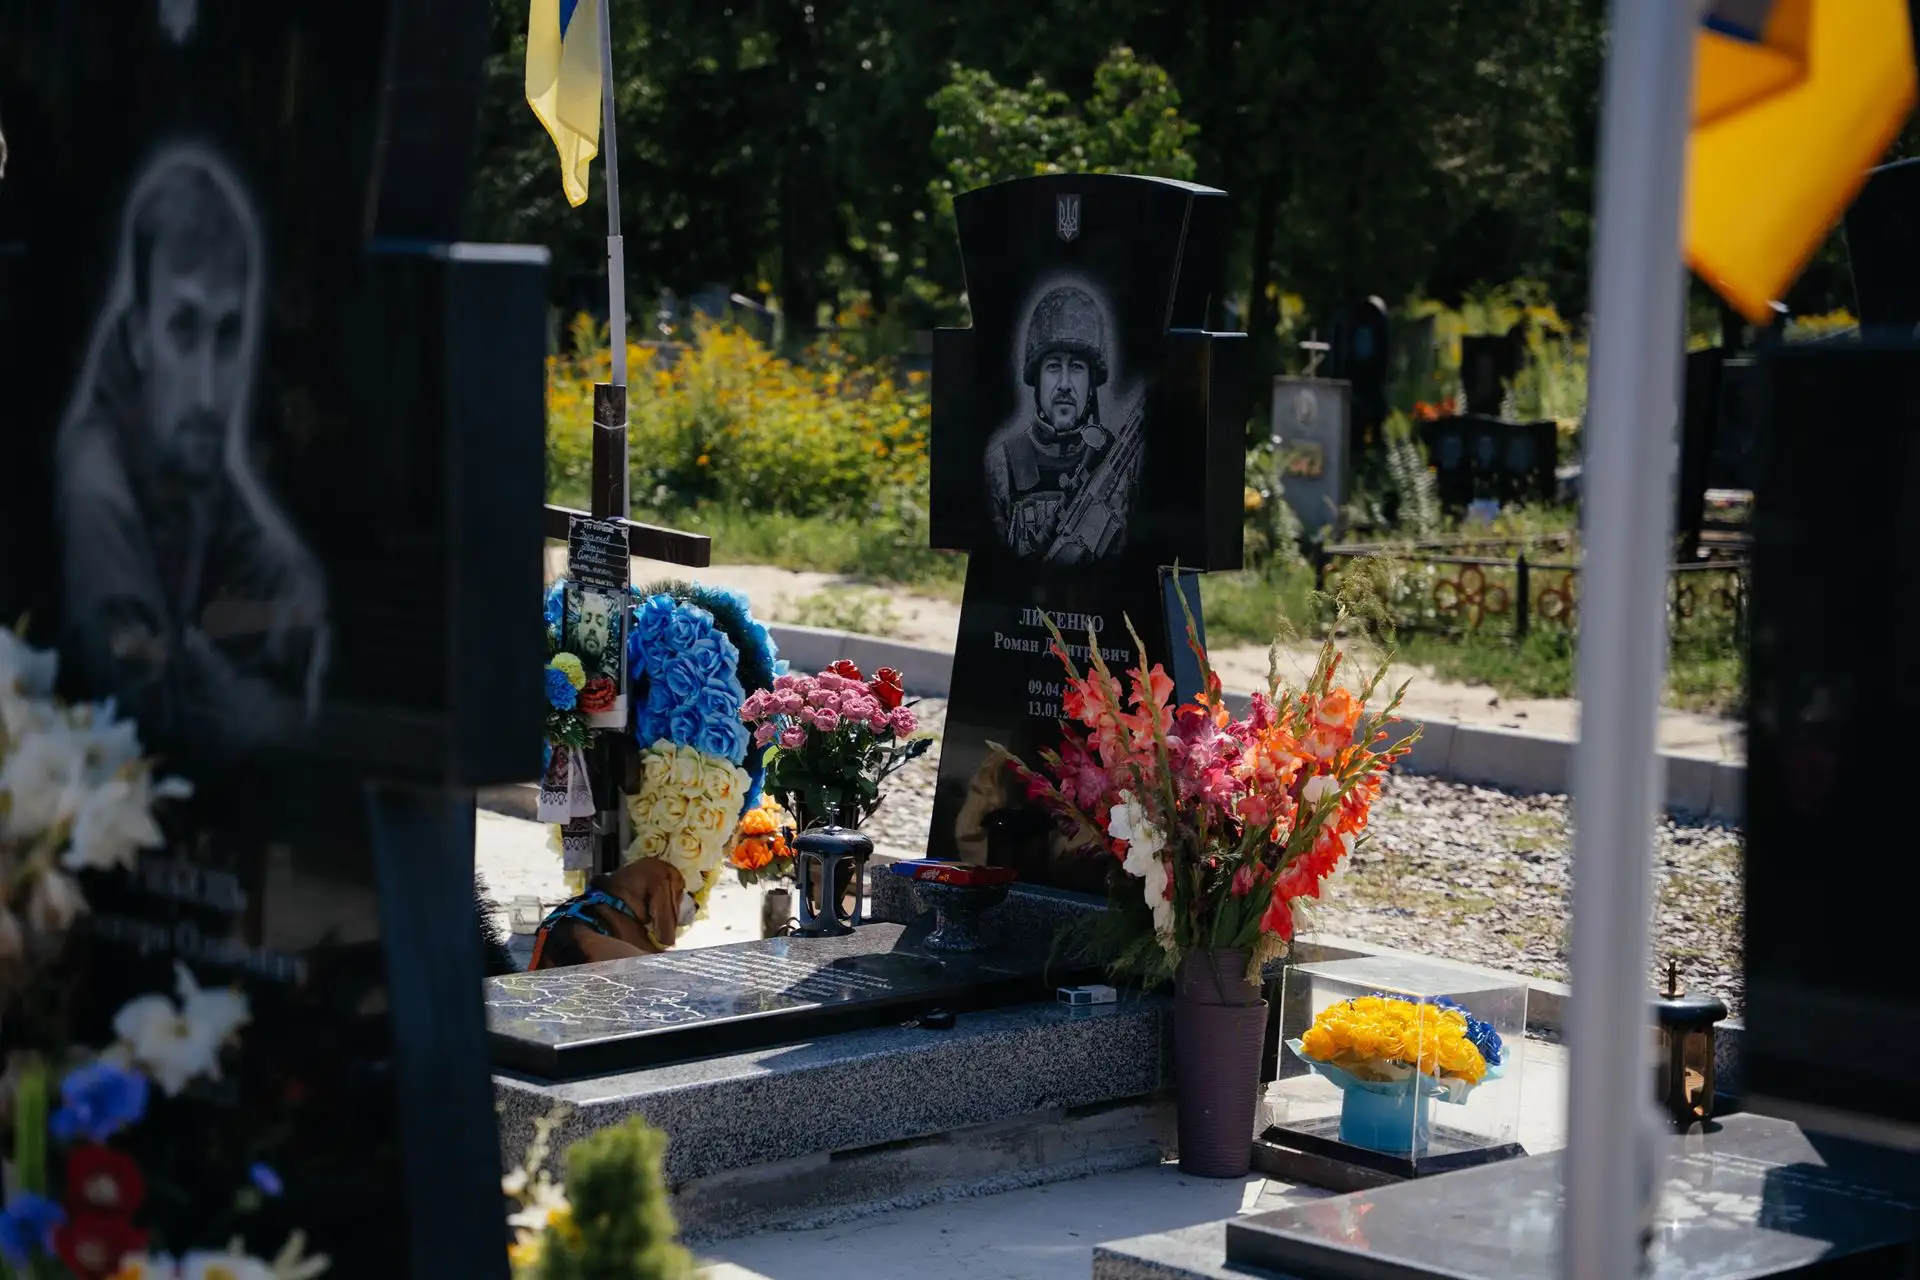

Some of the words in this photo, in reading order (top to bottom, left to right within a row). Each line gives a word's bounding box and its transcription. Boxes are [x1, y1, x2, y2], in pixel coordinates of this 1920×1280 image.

[993, 631, 1039, 653] Роман
[1042, 636, 1130, 664] Дитрвич
[1028, 679, 1077, 697] 09.04.
